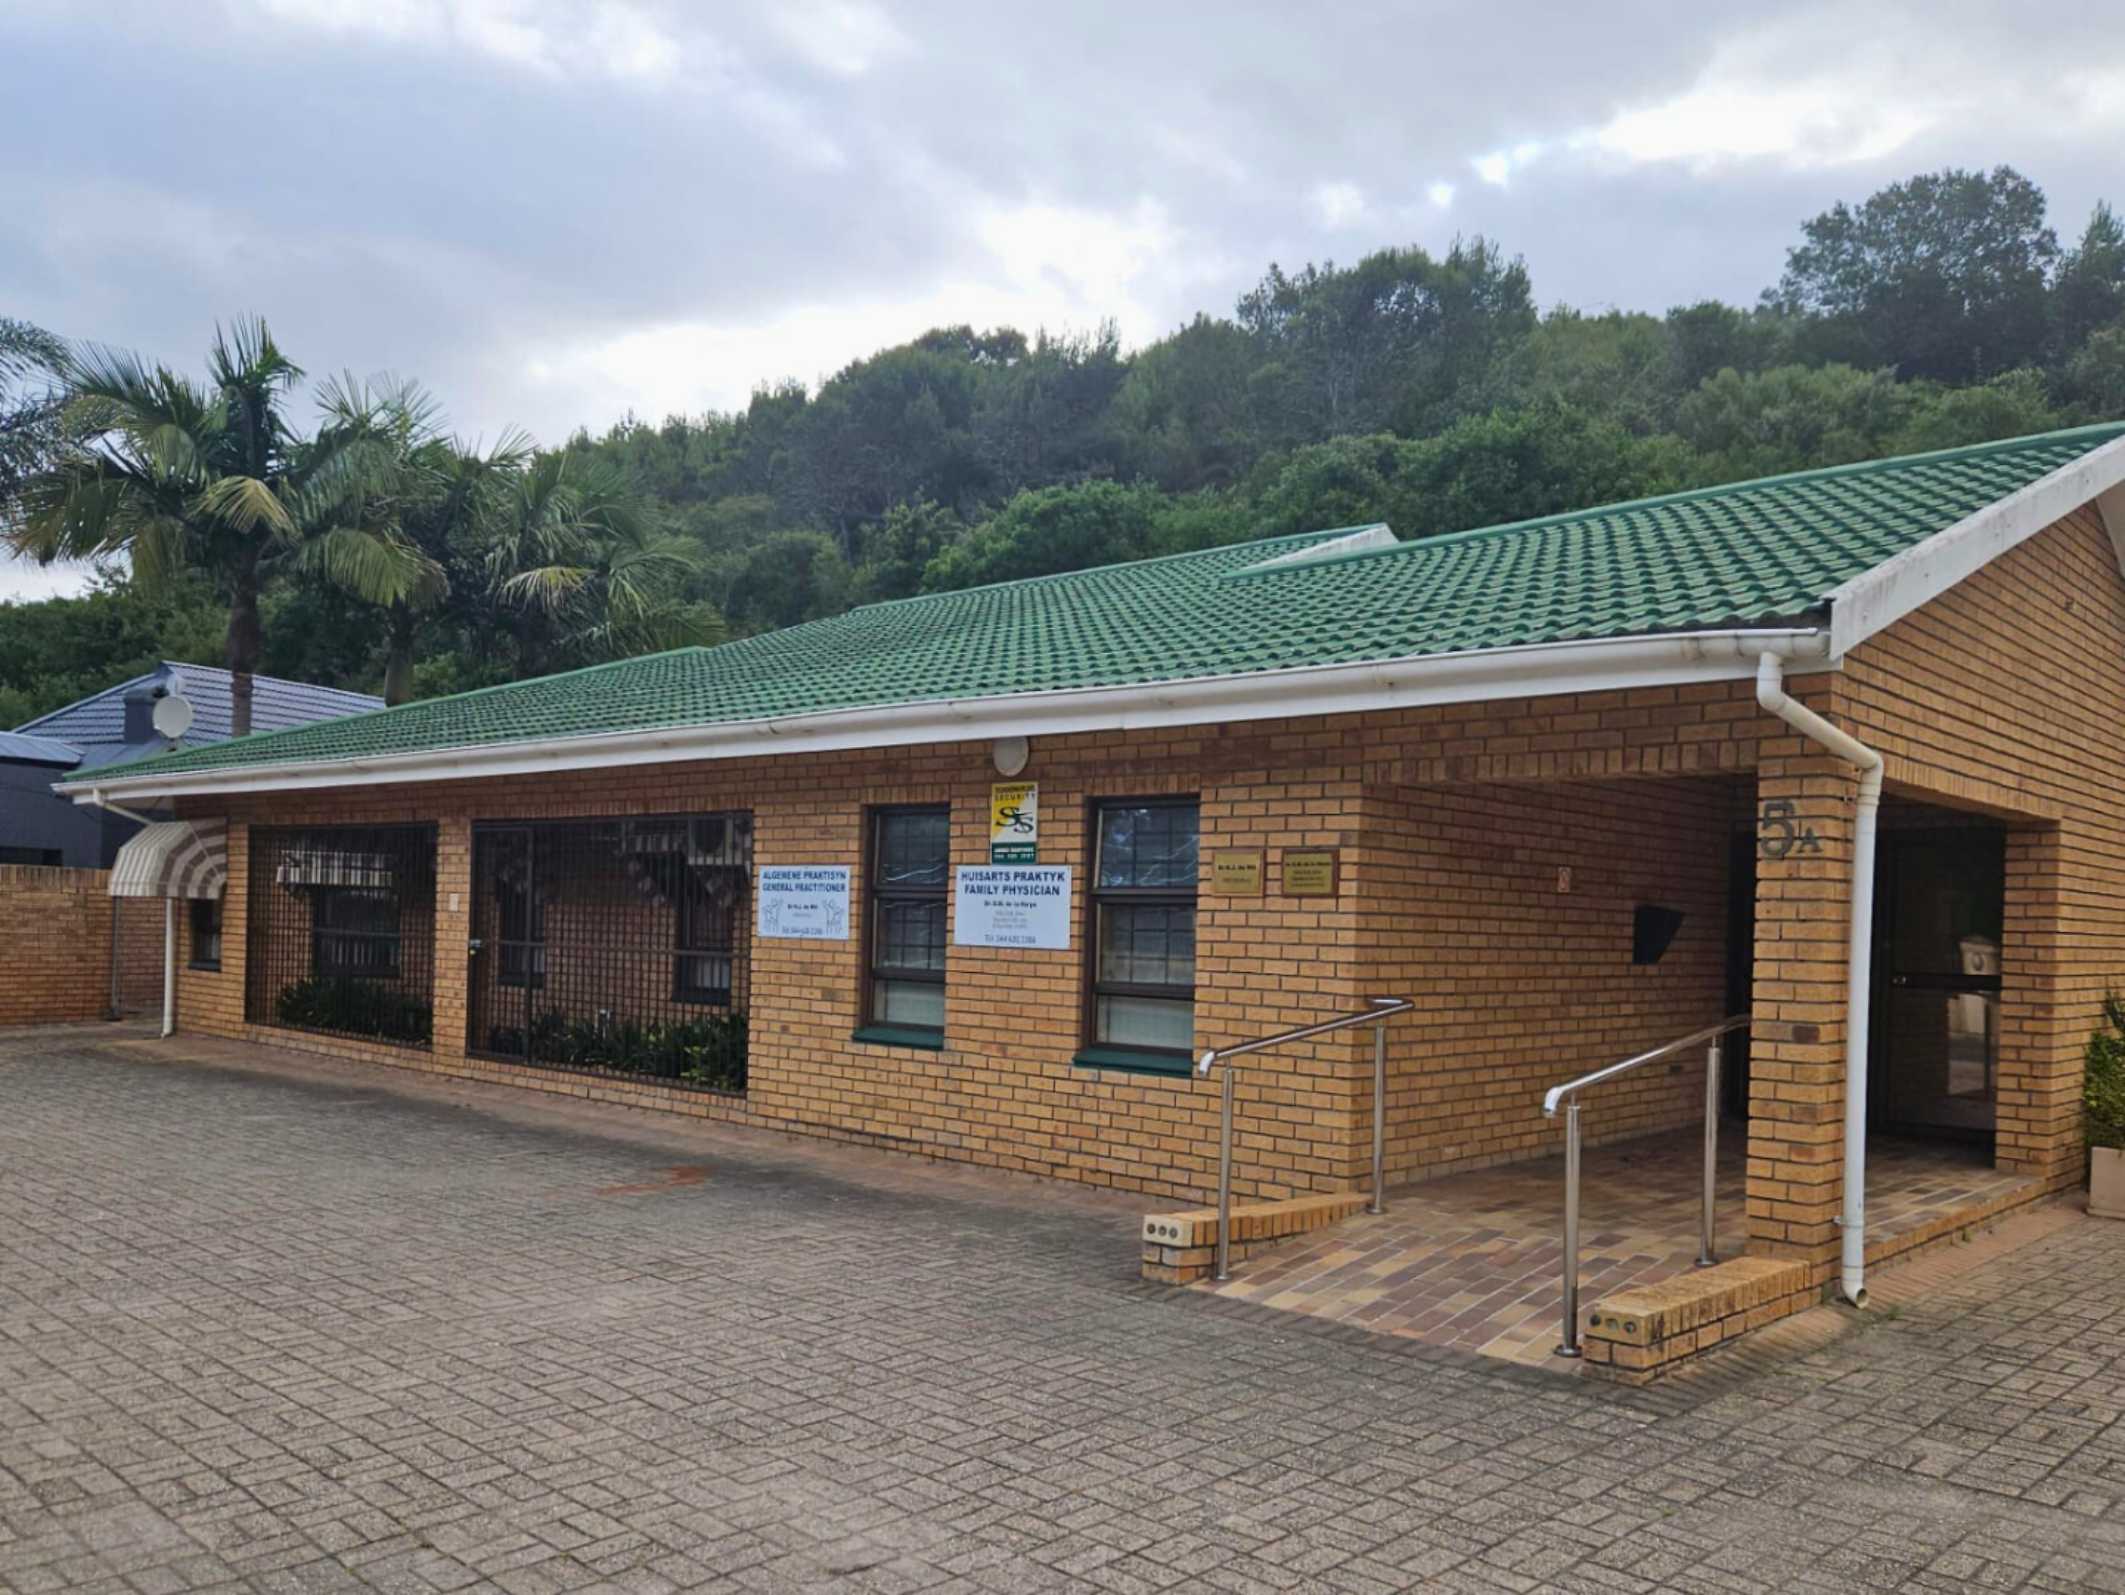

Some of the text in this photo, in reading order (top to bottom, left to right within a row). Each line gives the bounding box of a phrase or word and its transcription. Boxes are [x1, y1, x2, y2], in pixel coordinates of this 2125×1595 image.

[763, 871, 846, 881] ALGEMENE PRAKTISYN
[961, 871, 1065, 882] HUISARTS PRAKTYK
[762, 882, 846, 893] GENERAL PRACTITIONER
[964, 884, 1060, 896] FAMILY PHYSICIAN
